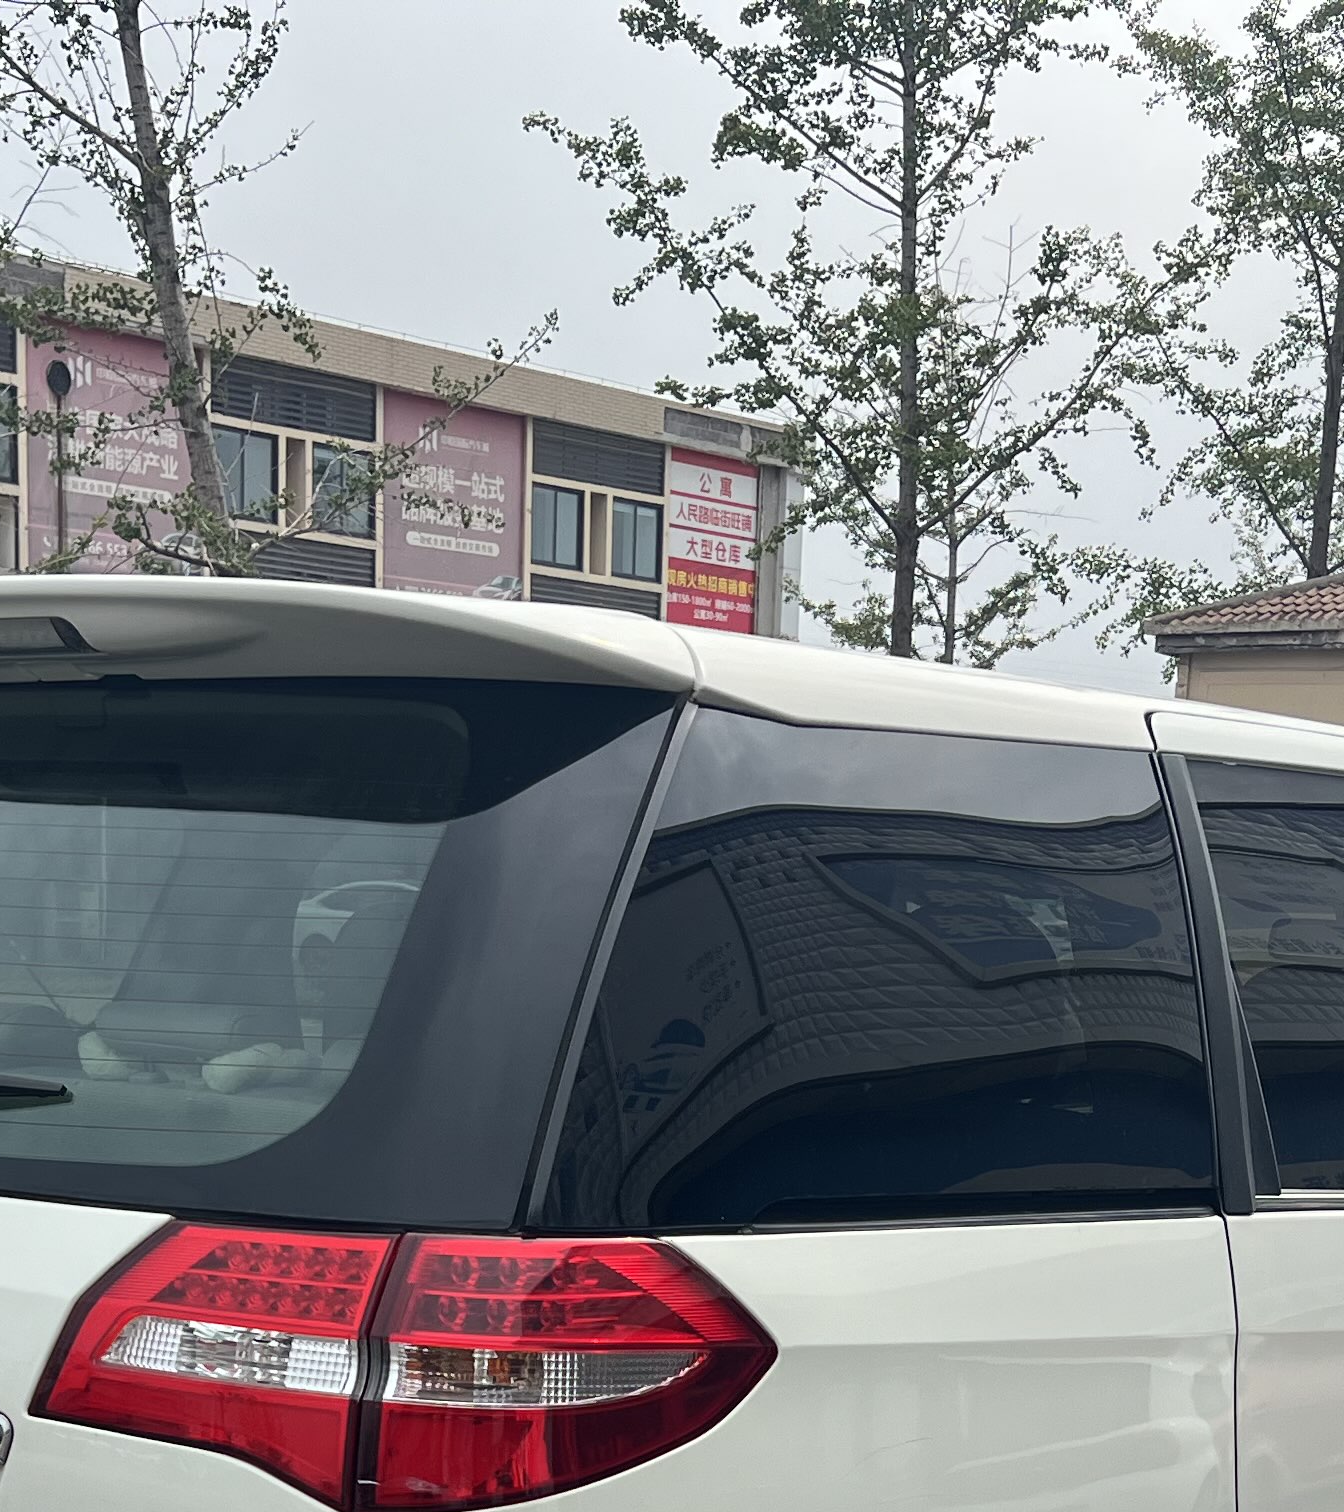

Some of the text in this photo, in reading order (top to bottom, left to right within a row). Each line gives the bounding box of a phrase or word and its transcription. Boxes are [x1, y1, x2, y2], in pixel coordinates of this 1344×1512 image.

[699, 472, 733, 498] 公寓
[686, 536, 741, 565] 大型仓库
